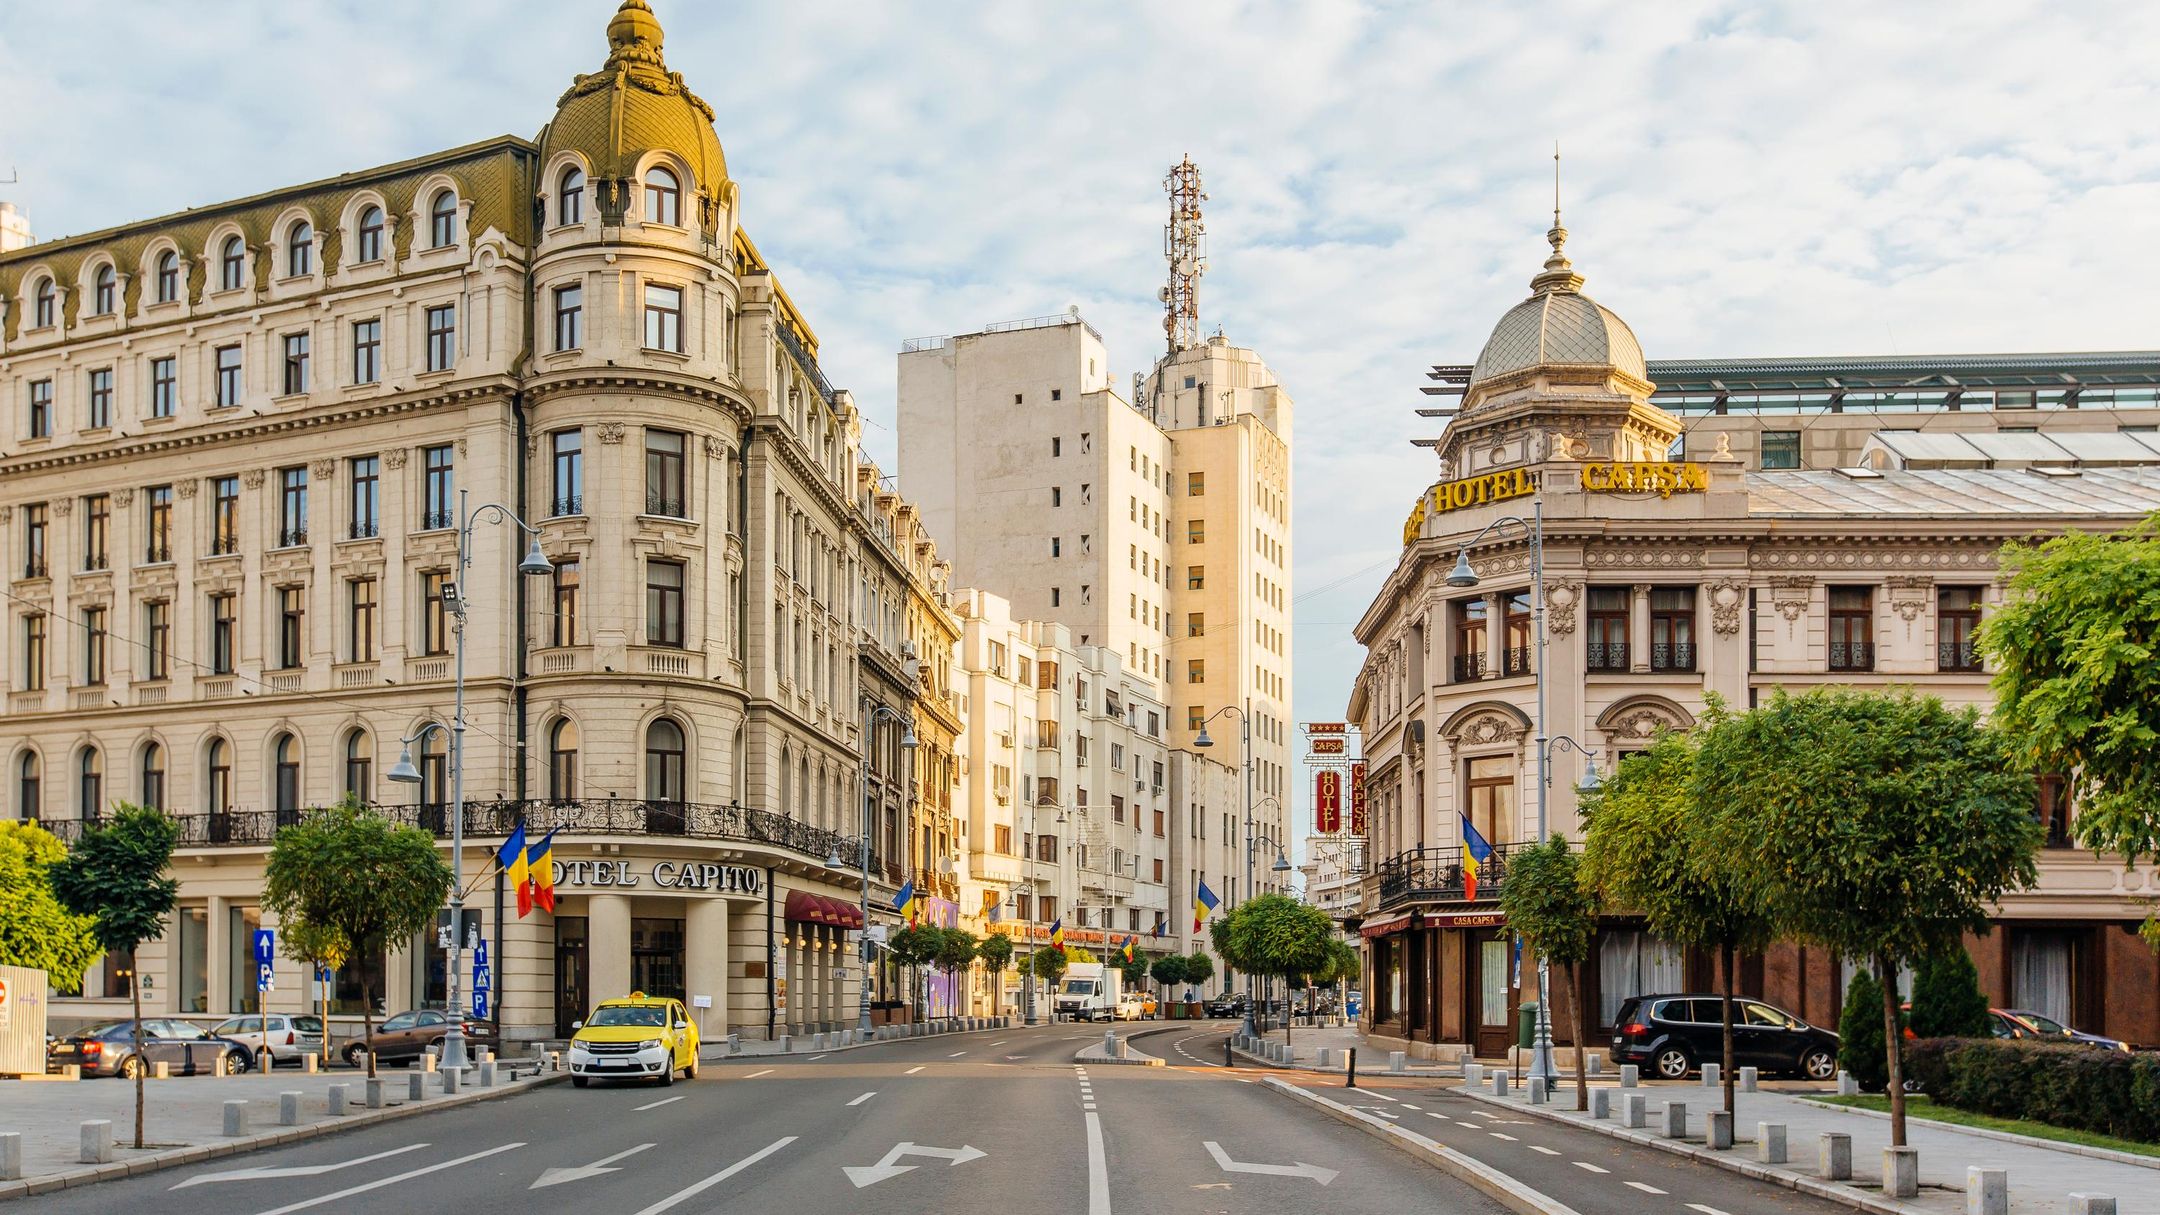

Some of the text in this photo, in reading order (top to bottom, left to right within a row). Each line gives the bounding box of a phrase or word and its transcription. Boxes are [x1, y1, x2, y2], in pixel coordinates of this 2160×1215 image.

[1434, 468, 1535, 512] HOTEL
[1322, 771, 1335, 833] HOTEL
[652, 861, 763, 893] CAPITOL
[1453, 916, 1472, 925] CASA
[474, 994, 484, 1010] P
